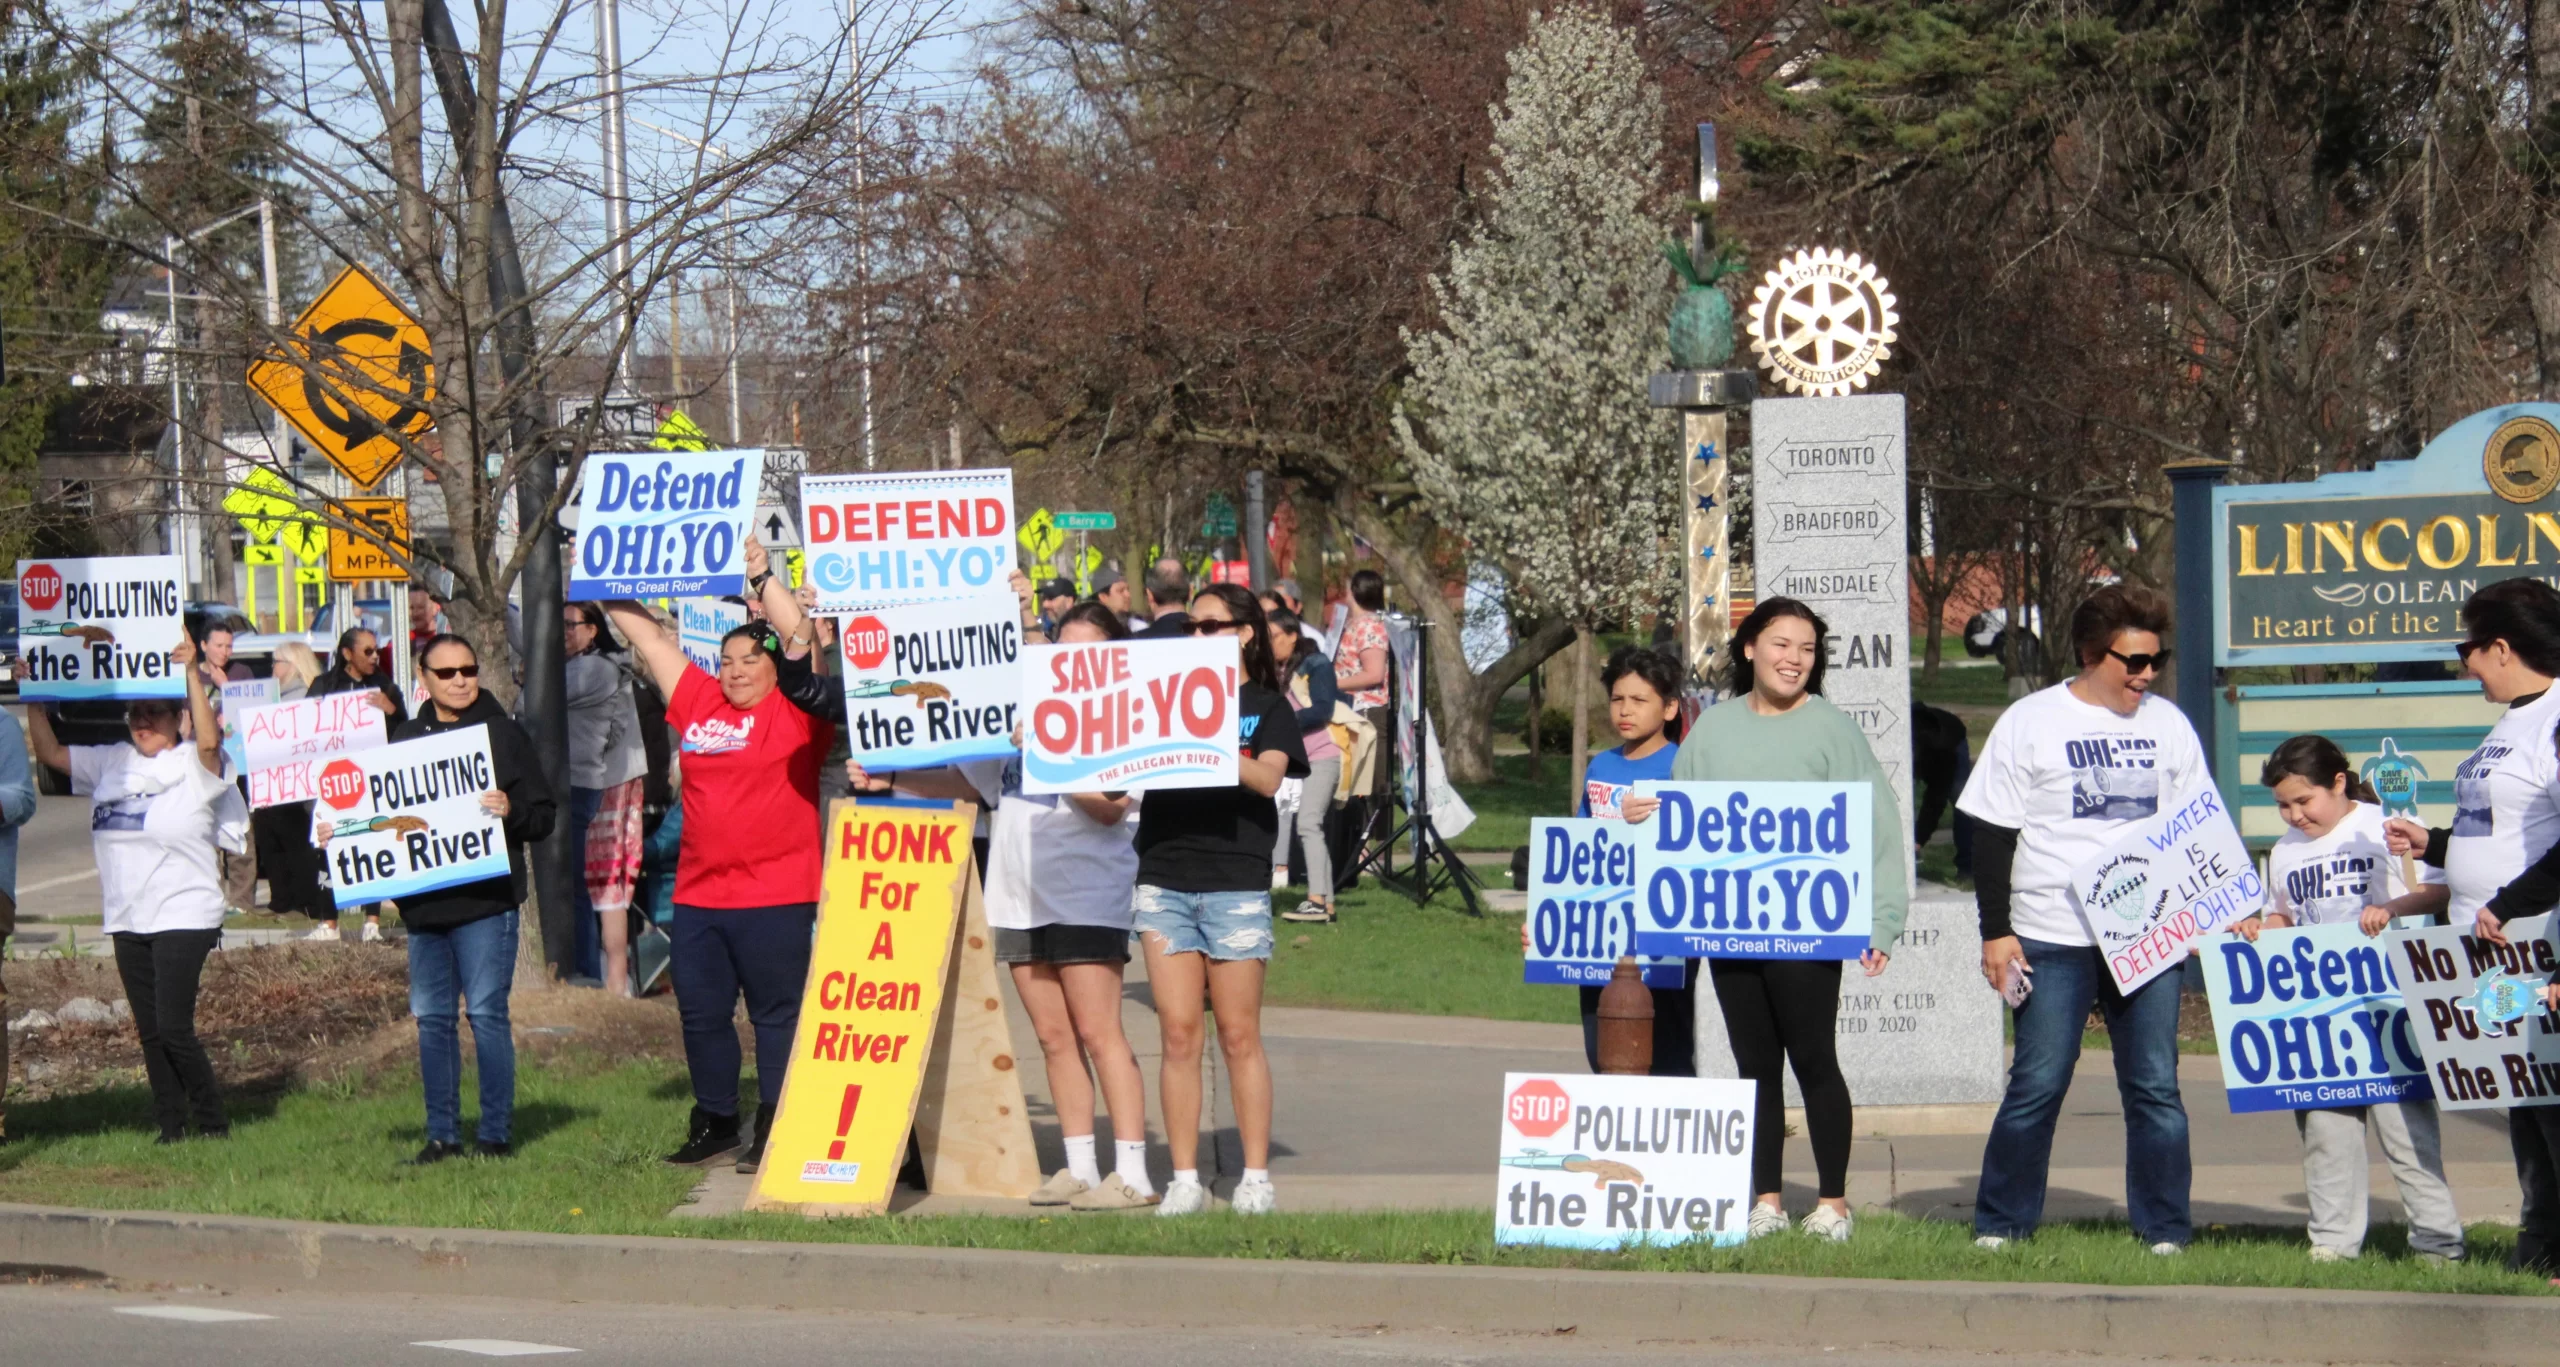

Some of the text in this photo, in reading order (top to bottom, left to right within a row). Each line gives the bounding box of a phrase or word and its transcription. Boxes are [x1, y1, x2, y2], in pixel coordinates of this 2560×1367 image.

[1792, 264, 1854, 283] ROTARY
[1774, 343, 1877, 383] INTERNATIONAL
[764, 454, 802, 470] UCK
[1786, 446, 1876, 468] TORONTO
[596, 458, 745, 512] Defend
[808, 498, 1006, 543] DEFEND
[1784, 510, 1879, 531] BRADFORD
[347, 555, 393, 569] MPH
[583, 521, 743, 578] OHI:YO'
[23, 577, 60, 598] STOP
[66, 580, 177, 619] POLLUTING
[605, 580, 708, 594] "The Great River"
[1785, 574, 1878, 595] HINSDALE
[2374, 579, 2477, 605] OLEAN
[683, 603, 741, 634] Clean Rive
[2253, 614, 2336, 639] Heart
[2348, 611, 2379, 635] of
[2391, 610, 2439, 634] the
[846, 629, 886, 656] STOP
[893, 621, 1017, 676] POLLUTING
[1824, 634, 1893, 670] EAN
[27, 643, 173, 681] the River
[1051, 647, 1132, 694] SAVE
[252, 684, 264, 697] LIFE
[248, 693, 374, 743] ACT LIKE
[856, 699, 1017, 751] the River
[1033, 665, 1236, 756] OHI:YO'
[291, 735, 345, 756] ITS AN
[250, 760, 318, 806] EMERG
[323, 771, 363, 799] STOP
[369, 751, 490, 813] POLLUTING
[1097, 768, 1119, 784] THE
[1123, 753, 1183, 775] ALLEGANY
[1187, 753, 1221, 766] RIVER
[2379, 777, 2408, 785] TURTLE
[2381, 770, 2402, 778] SAVE
[2380, 785, 2409, 793] ISLAND
[1655, 789, 1851, 853] Defend
[2146, 791, 2220, 852] WATER
[336, 826, 494, 886] the River
[840, 821, 957, 863] HONK
[2185, 842, 2205, 866] IS
[859, 871, 919, 911] For
[2085, 853, 2150, 908] Turtle Island Women
[2178, 852, 2228, 901] LIFE
[1647, 866, 1859, 933] OHI:YO'
[867, 921, 893, 960] A
[1534, 898, 1636, 959] OHI:Y
[1684, 936, 1822, 953] "The Great River"
[1900, 929, 1940, 946] TH?
[2112, 911, 2195, 985] DEFEND
[2403, 935, 2557, 983] No More
[819, 970, 921, 1011] Clean
[1556, 964, 1582, 979] "The
[1894, 993, 1936, 1010] CLUB
[2496, 984, 2504, 1016] DEFEND
[813, 1022, 909, 1064] River
[1879, 1016, 1917, 1033] 2020
[2230, 1005, 2426, 1084] OHI:YO
[2275, 1079, 2413, 1103] "The Great River"
[2437, 1051, 2560, 1102] the Riv
[1511, 1095, 1566, 1122] STOP
[1573, 1105, 1745, 1156] POLLUTING
[804, 1162, 829, 1175] DEFEND
[1508, 1181, 1736, 1231] the River
